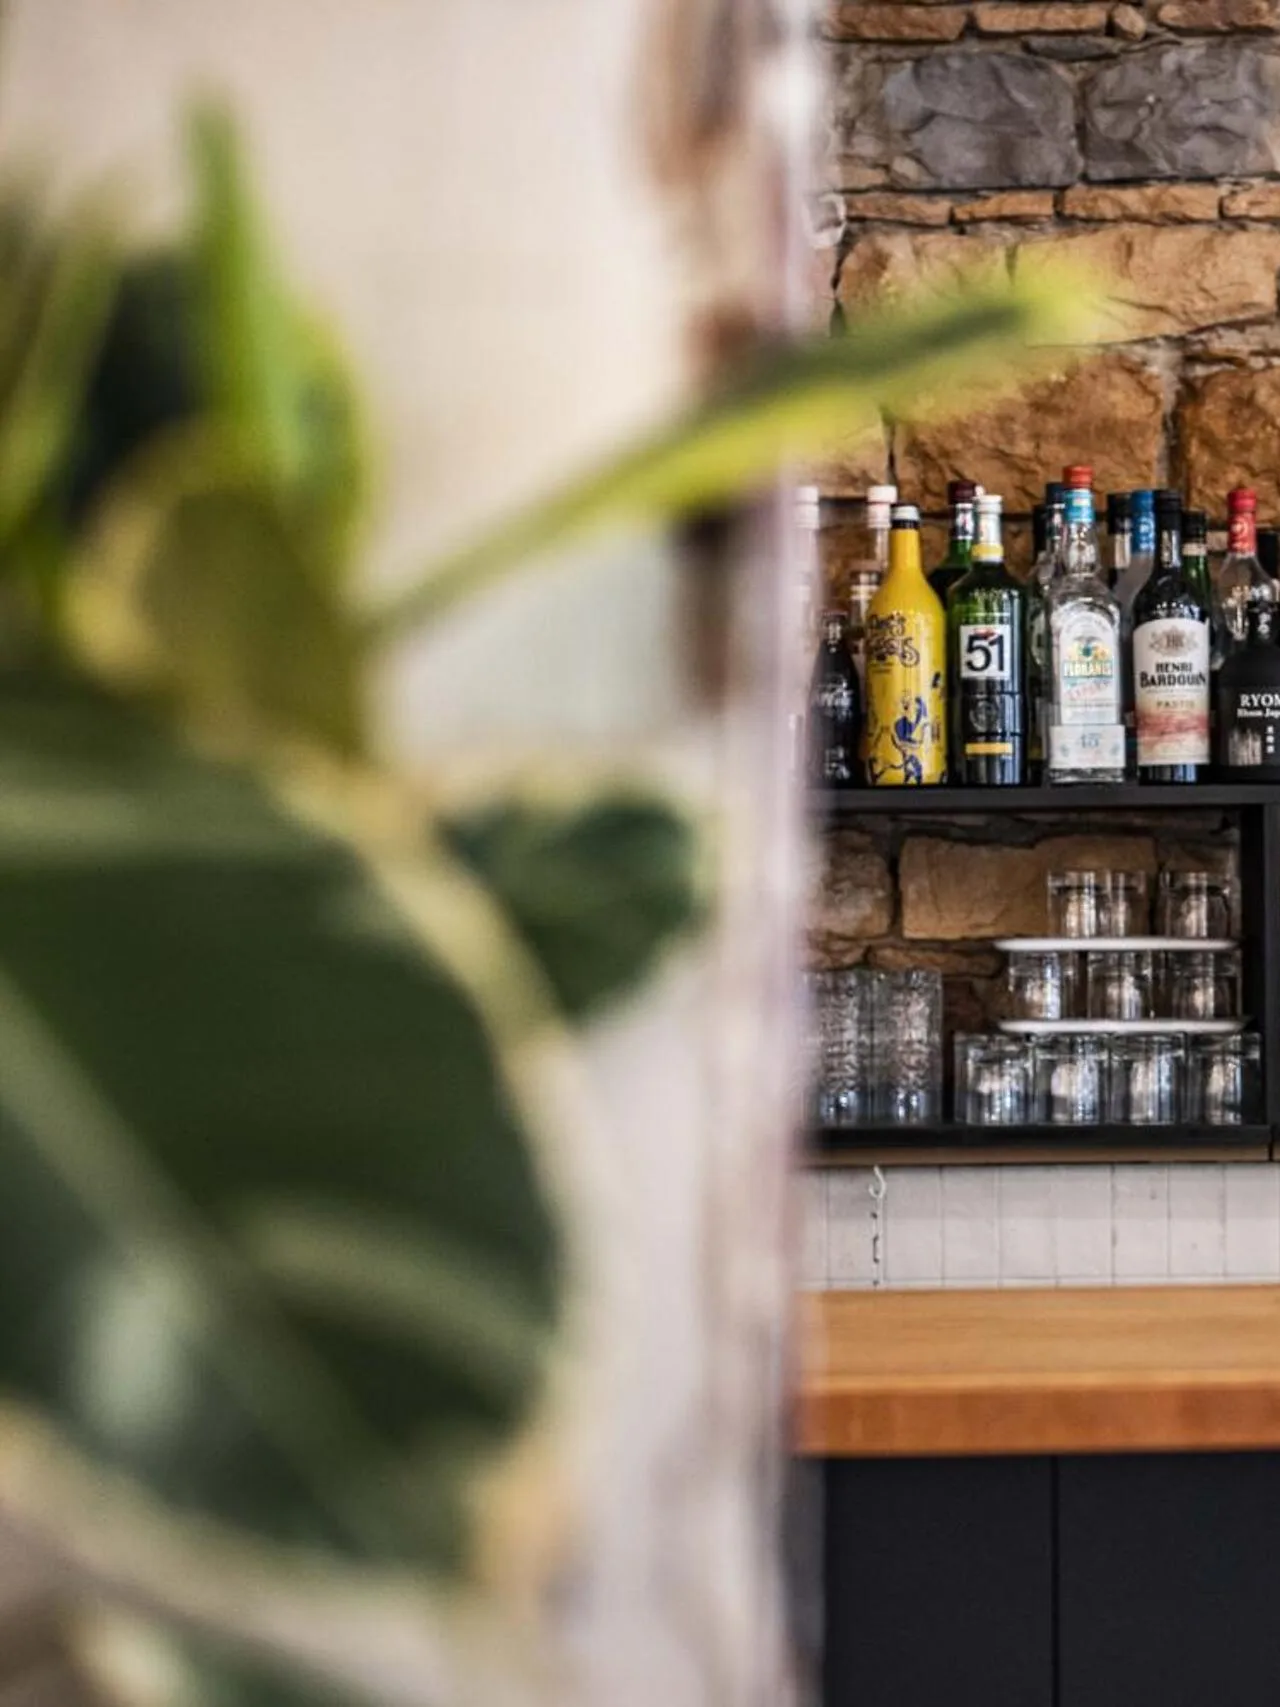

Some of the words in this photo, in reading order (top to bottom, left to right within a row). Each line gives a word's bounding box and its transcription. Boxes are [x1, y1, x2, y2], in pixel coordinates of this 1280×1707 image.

[966, 634, 1004, 672] 51
[1155, 662, 1193, 673] HENRI
[1140, 671, 1206, 688] BARDOUIN
